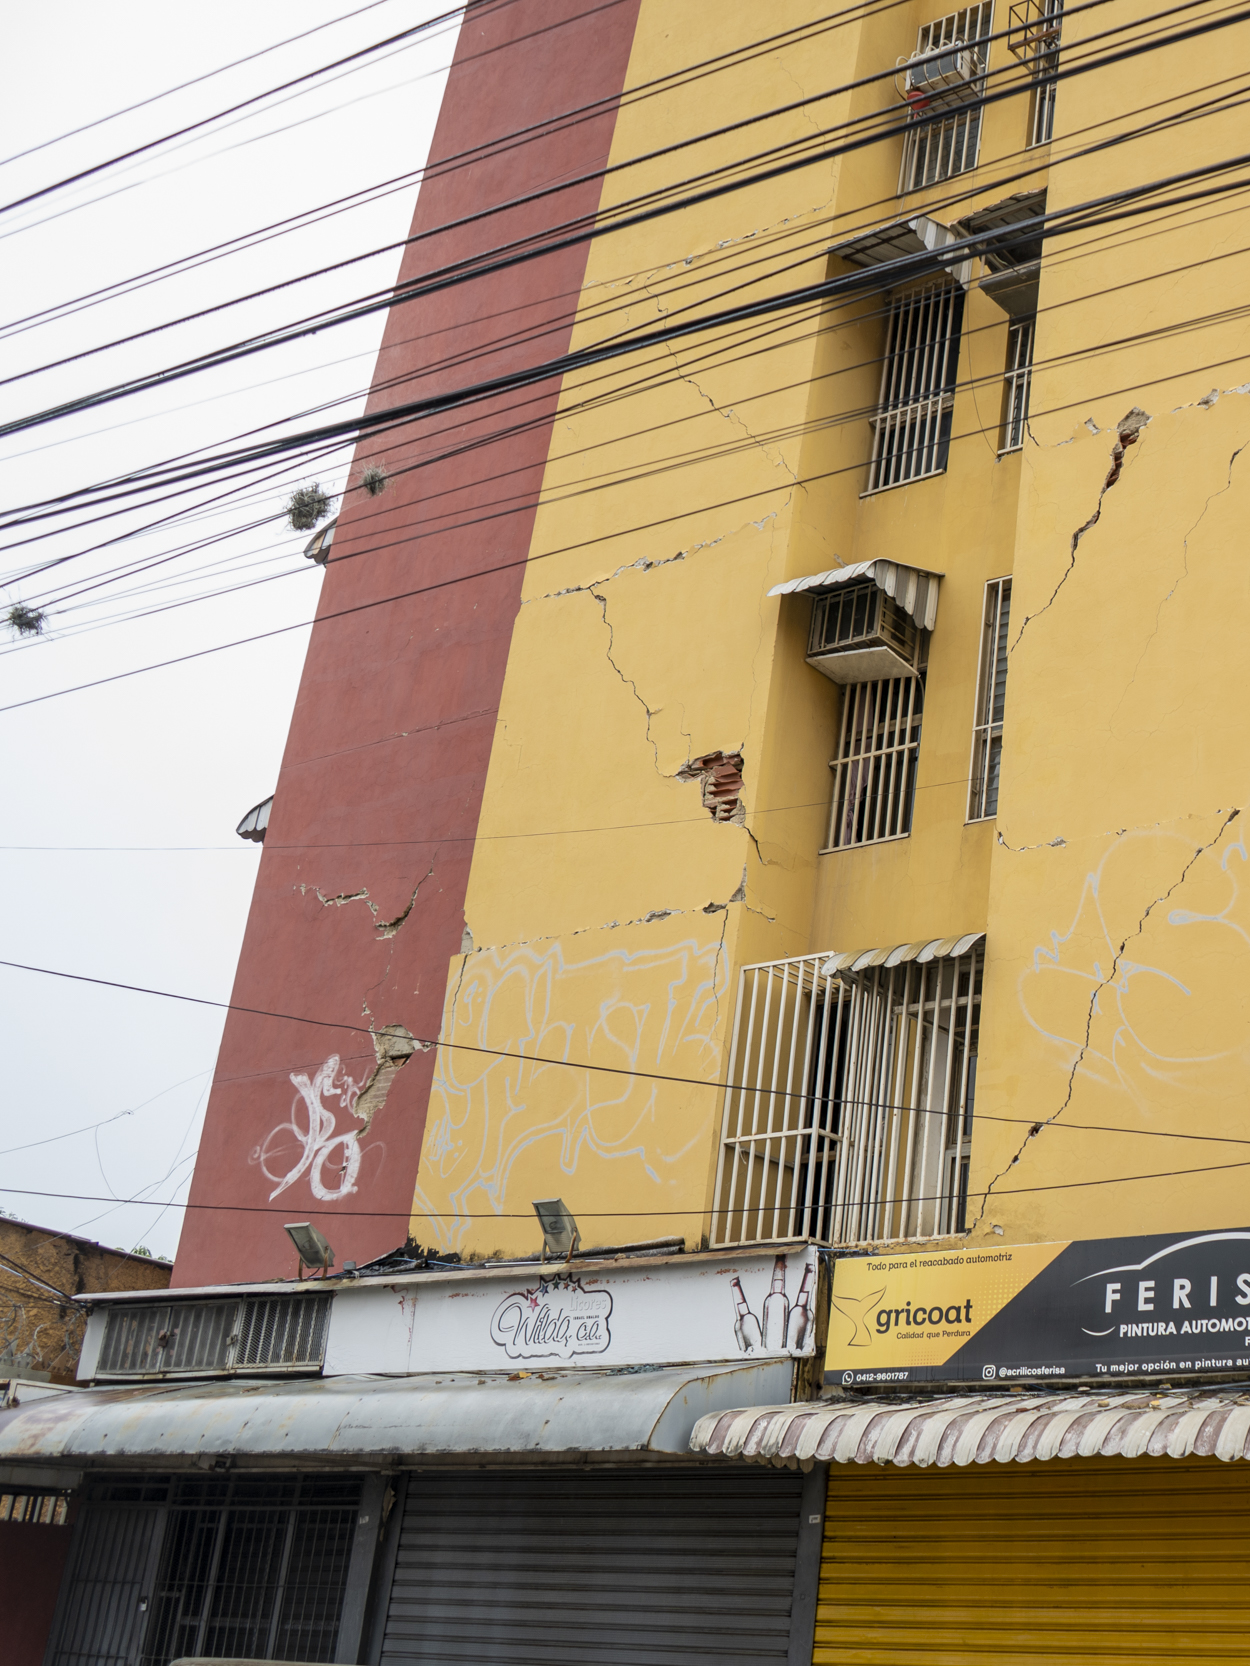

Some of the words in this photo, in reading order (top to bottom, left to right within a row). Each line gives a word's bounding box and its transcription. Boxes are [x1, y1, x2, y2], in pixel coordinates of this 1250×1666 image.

[866, 1261, 887, 1271] Todo
[888, 1261, 908, 1272] para
[909, 1259, 918, 1268] el
[919, 1256, 965, 1267] reacabado
[966, 1252, 1013, 1264] automotriz
[569, 1296, 608, 1312] Licores
[875, 1299, 973, 1334] gricoat
[896, 1331, 924, 1340] Calidad
[926, 1332, 940, 1340] que
[942, 1329, 971, 1338] Perdura
[1119, 1321, 1177, 1337] PINTURA
[998, 1365, 1065, 1378] @acrilicosferisa
[1096, 1363, 1108, 1373] Tu
[1110, 1361, 1139, 1374] mejor
[1141, 1360, 1176, 1373] opción
[1179, 1360, 1192, 1369] en
[1195, 1357, 1233, 1370] pintura
[856, 1371, 909, 1382] 0412-9601787
